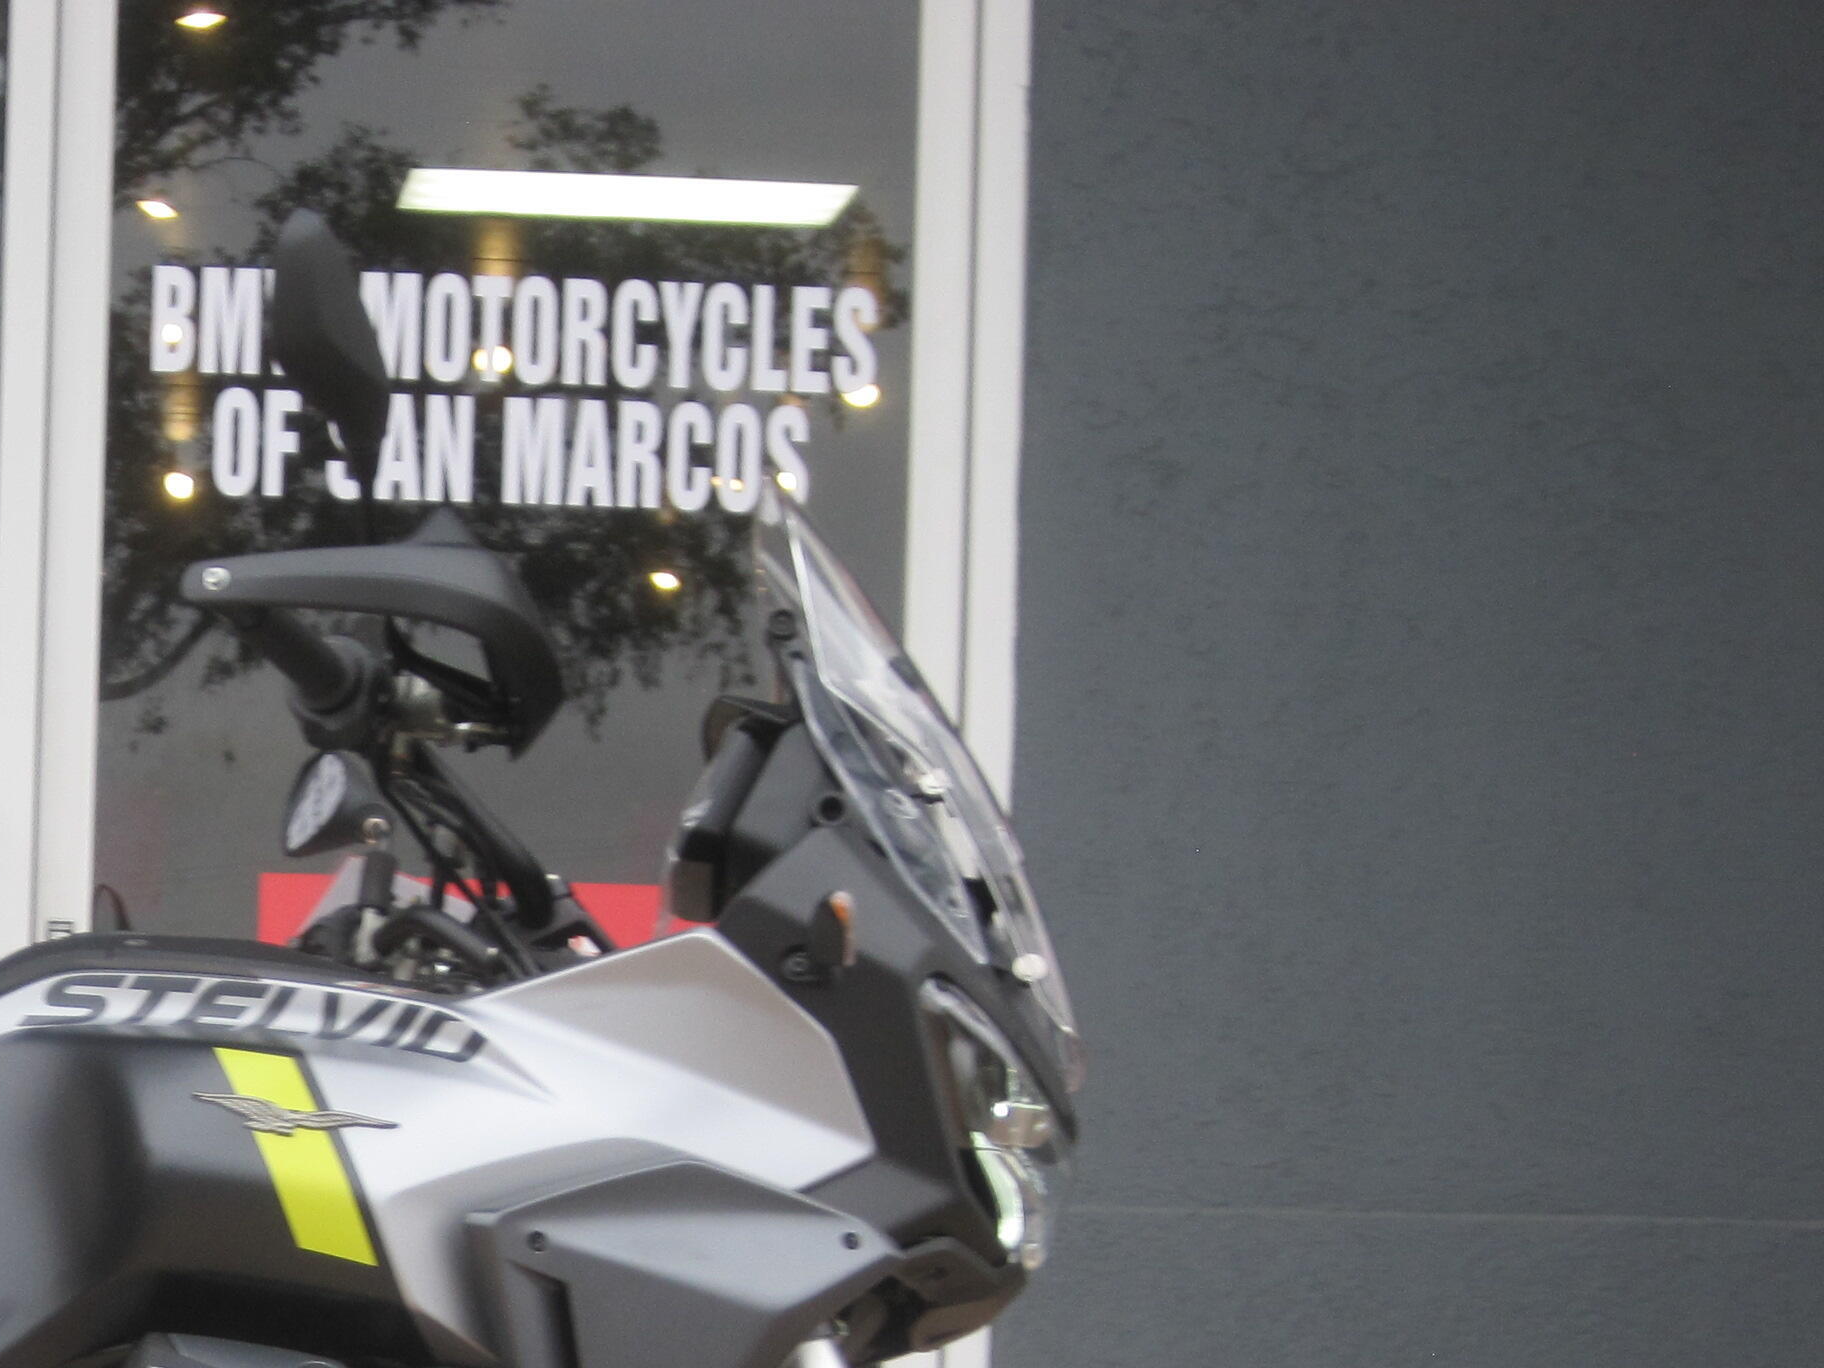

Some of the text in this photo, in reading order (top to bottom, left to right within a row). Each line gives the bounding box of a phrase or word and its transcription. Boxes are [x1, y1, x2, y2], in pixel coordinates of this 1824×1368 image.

[150, 265, 879, 394] BM MOTORCYCLES
[212, 387, 302, 498] OF
[501, 397, 811, 513] MARCOS
[22, 973, 489, 1063] STELVIO
